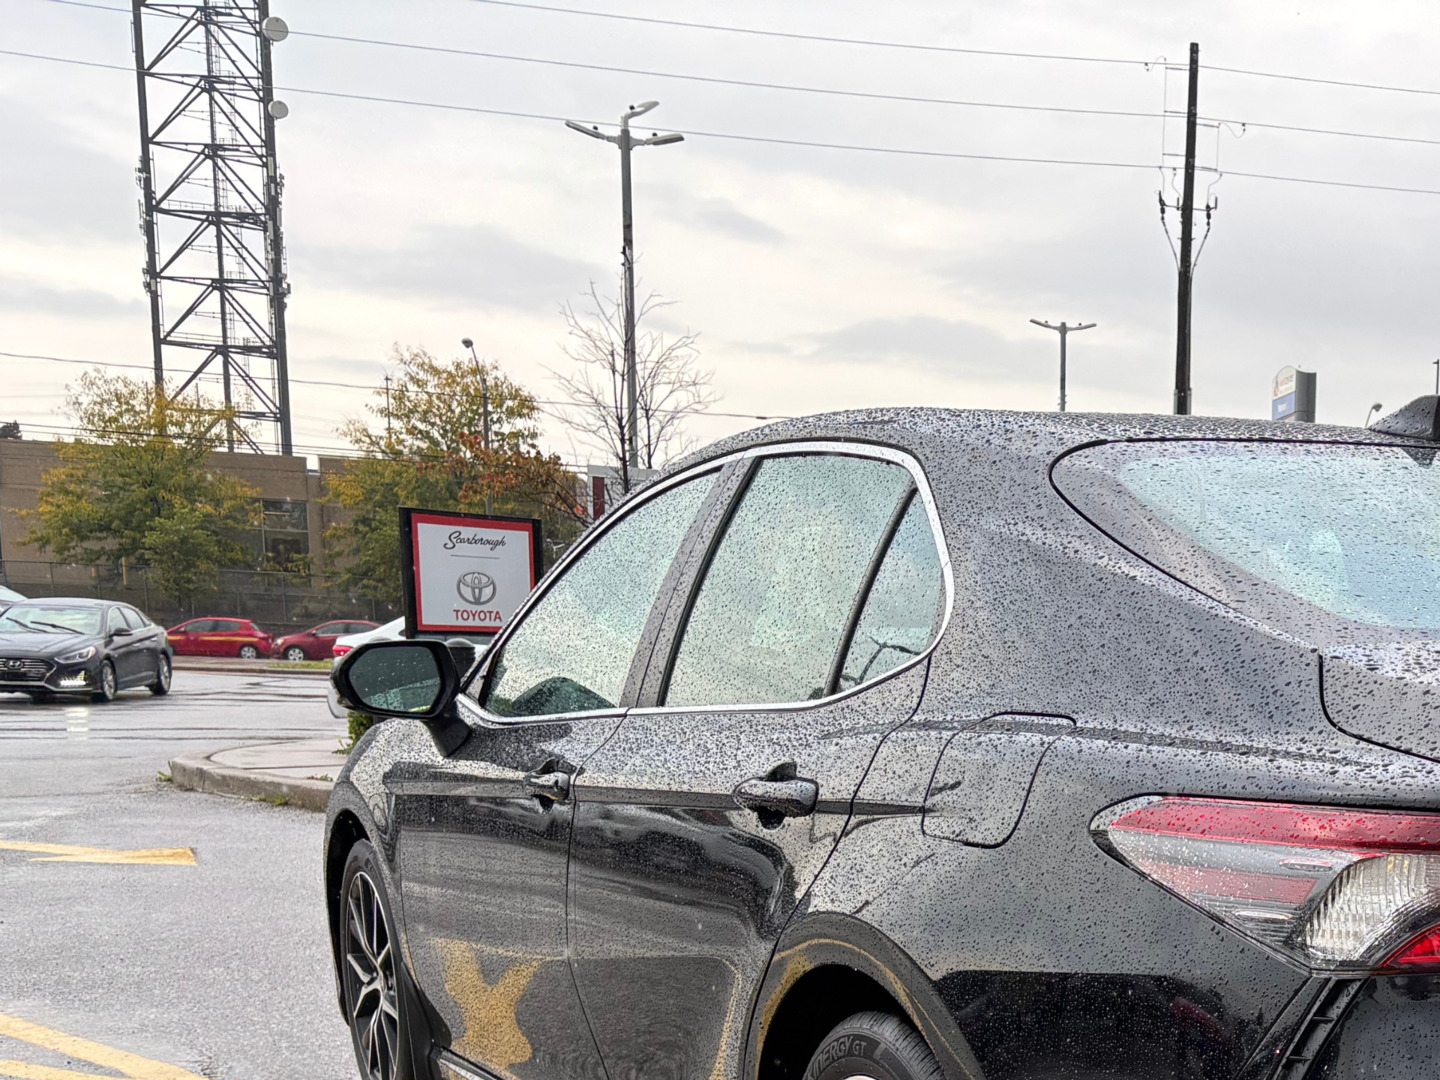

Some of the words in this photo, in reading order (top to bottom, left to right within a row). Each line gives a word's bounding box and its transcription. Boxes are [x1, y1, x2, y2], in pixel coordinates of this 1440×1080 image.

[443, 530, 506, 551] Scarborough
[453, 609, 502, 622] TOYOTA
[853, 1040, 867, 1057] GT
